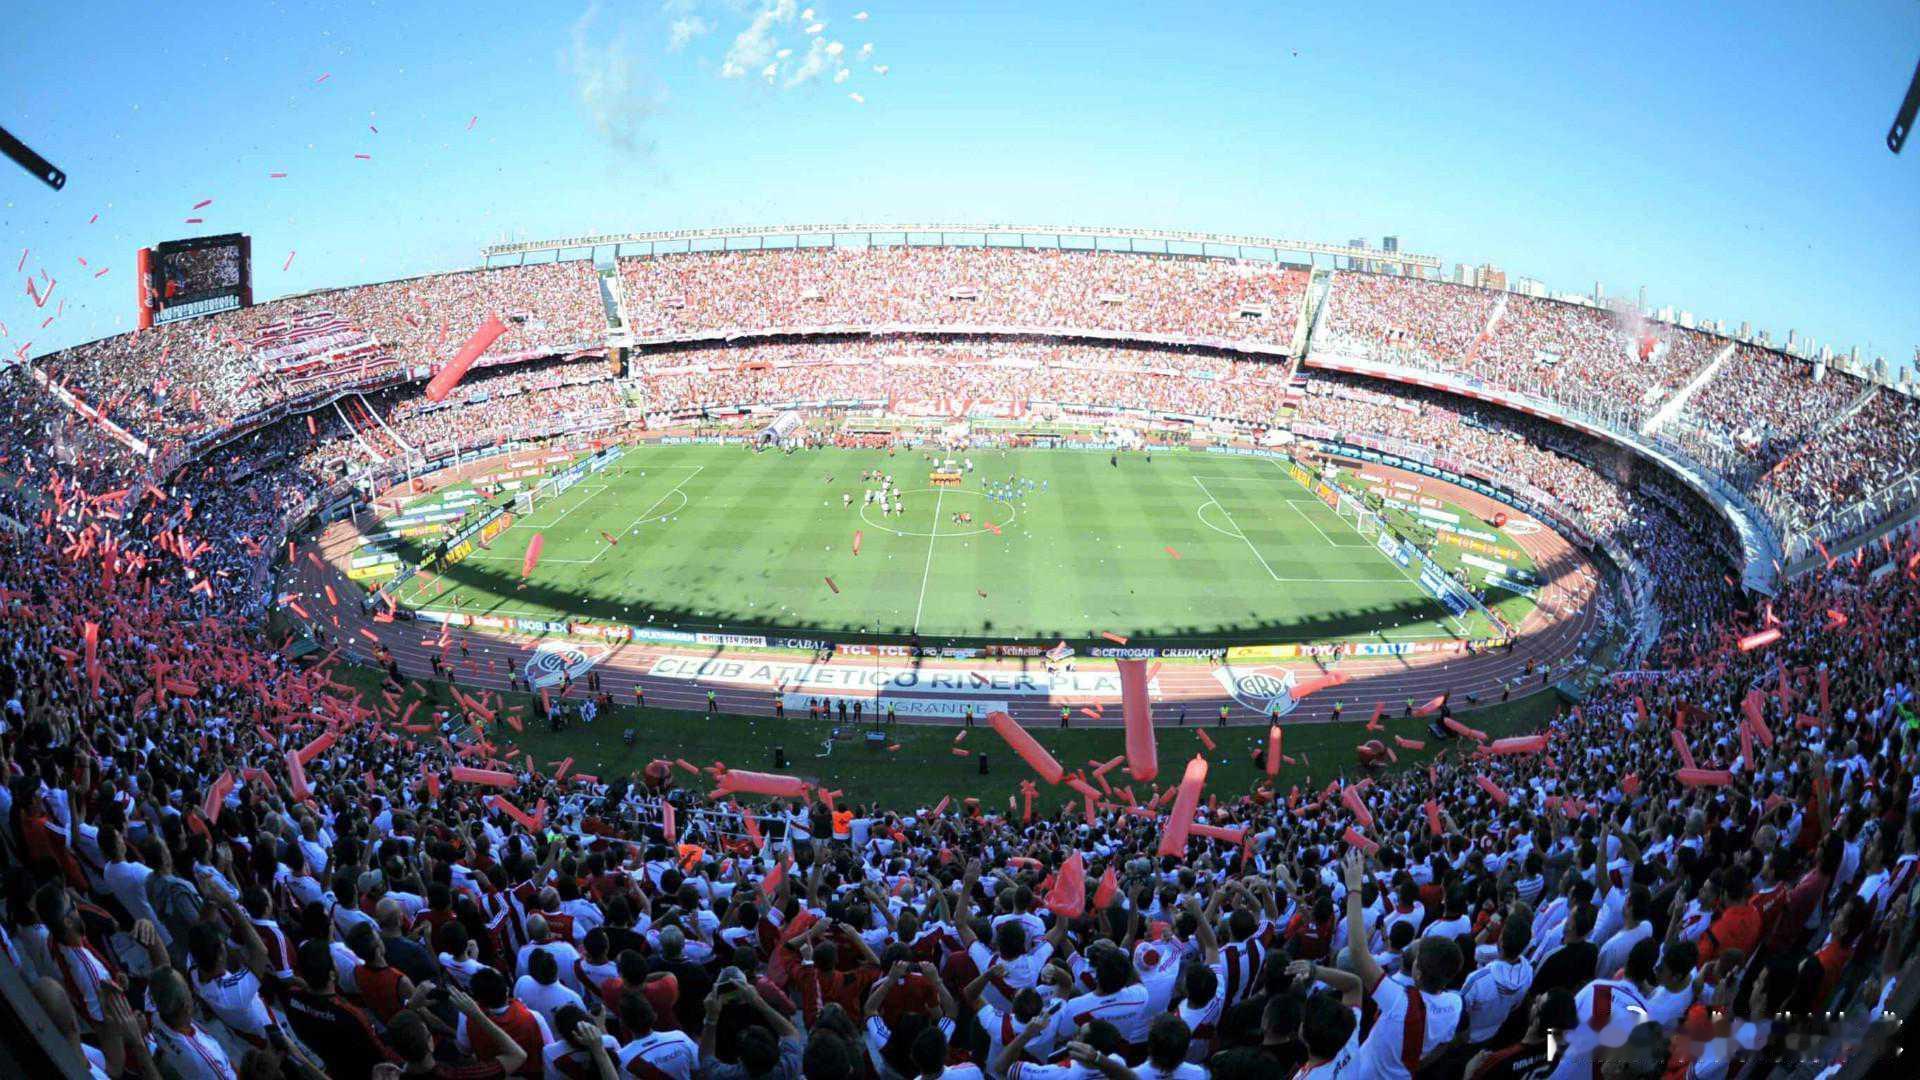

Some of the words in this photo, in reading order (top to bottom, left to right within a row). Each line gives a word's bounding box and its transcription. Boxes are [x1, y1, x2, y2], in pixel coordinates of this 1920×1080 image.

[518, 620, 567, 634] NOBLEX
[787, 638, 829, 650] CABAL
[841, 645, 871, 656] TCL
[878, 645, 908, 657] TCL
[1102, 648, 1155, 659] CETROGAR
[656, 657, 744, 679] CLUB
[749, 664, 919, 688] ATLETICO
[930, 672, 1038, 691] RIVER
